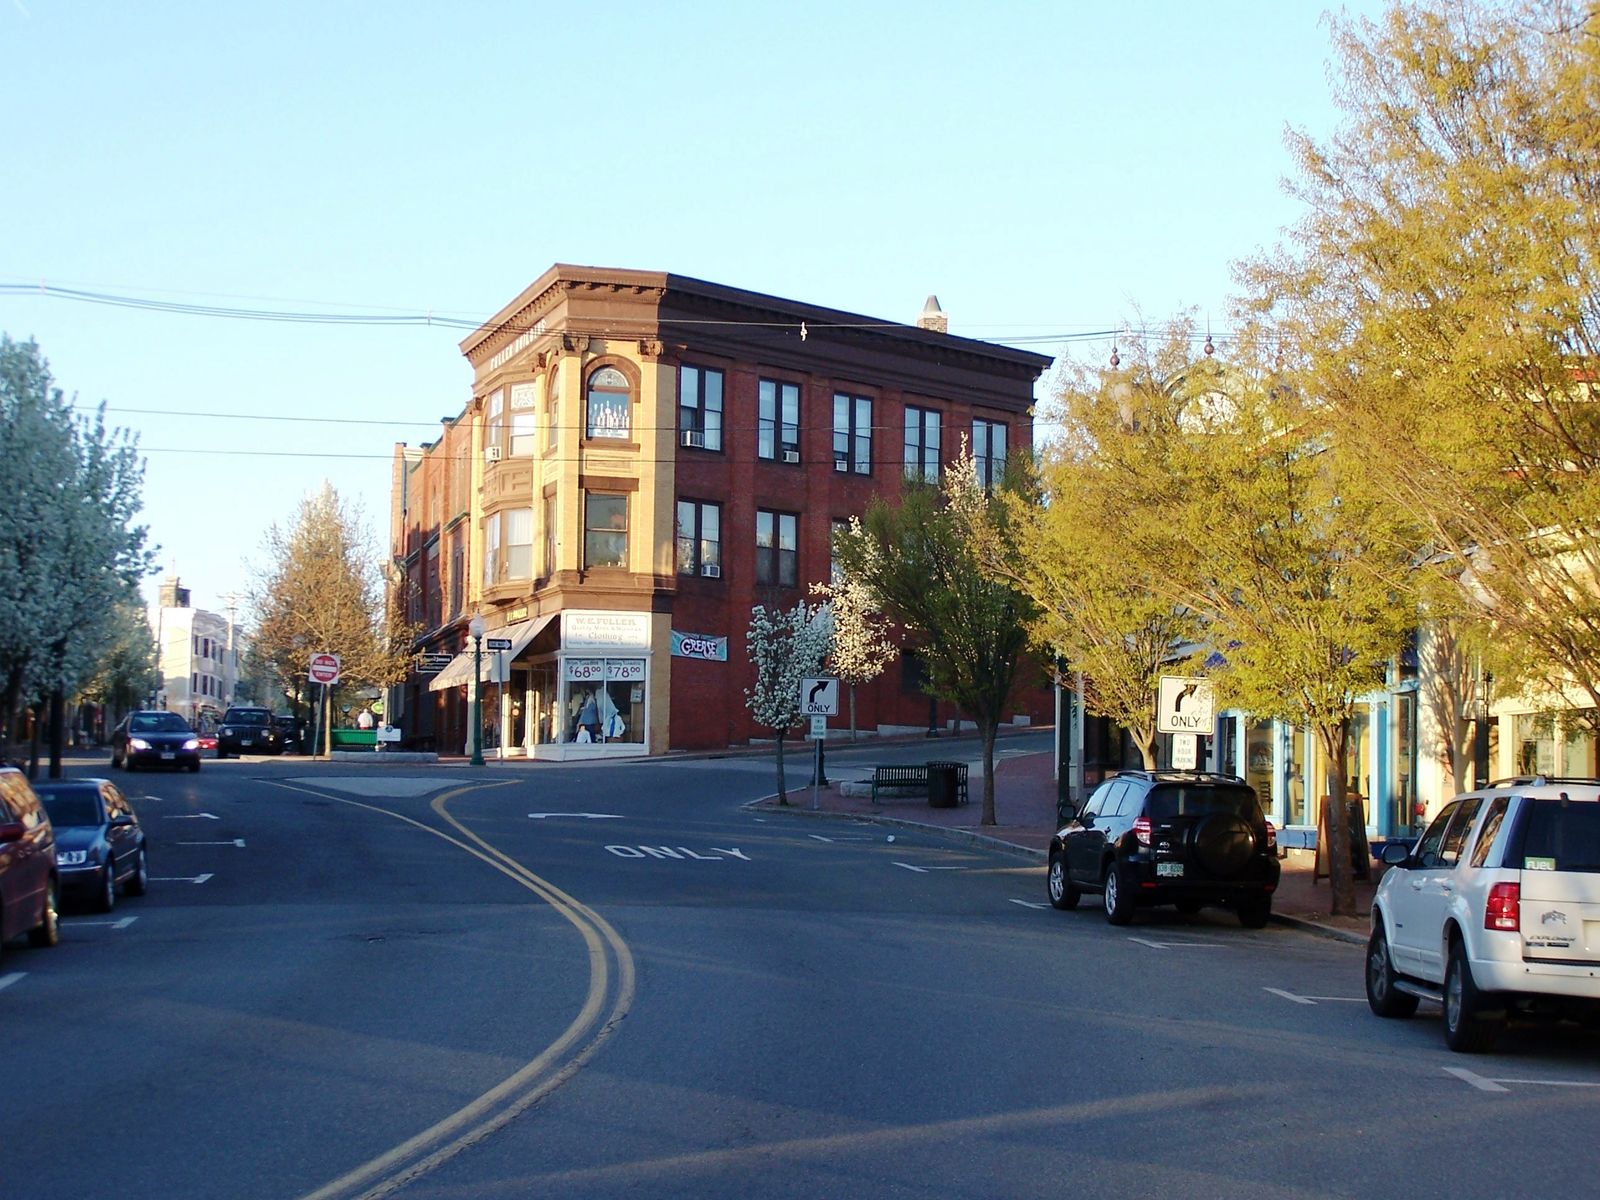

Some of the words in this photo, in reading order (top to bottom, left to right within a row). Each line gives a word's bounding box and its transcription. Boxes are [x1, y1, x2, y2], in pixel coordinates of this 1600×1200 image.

[597, 618, 637, 626] FULLER
[681, 638, 717, 659] GREASE
[807, 704, 831, 713] ONLY
[1171, 715, 1201, 728] ONLY
[603, 844, 752, 861] ONLY
